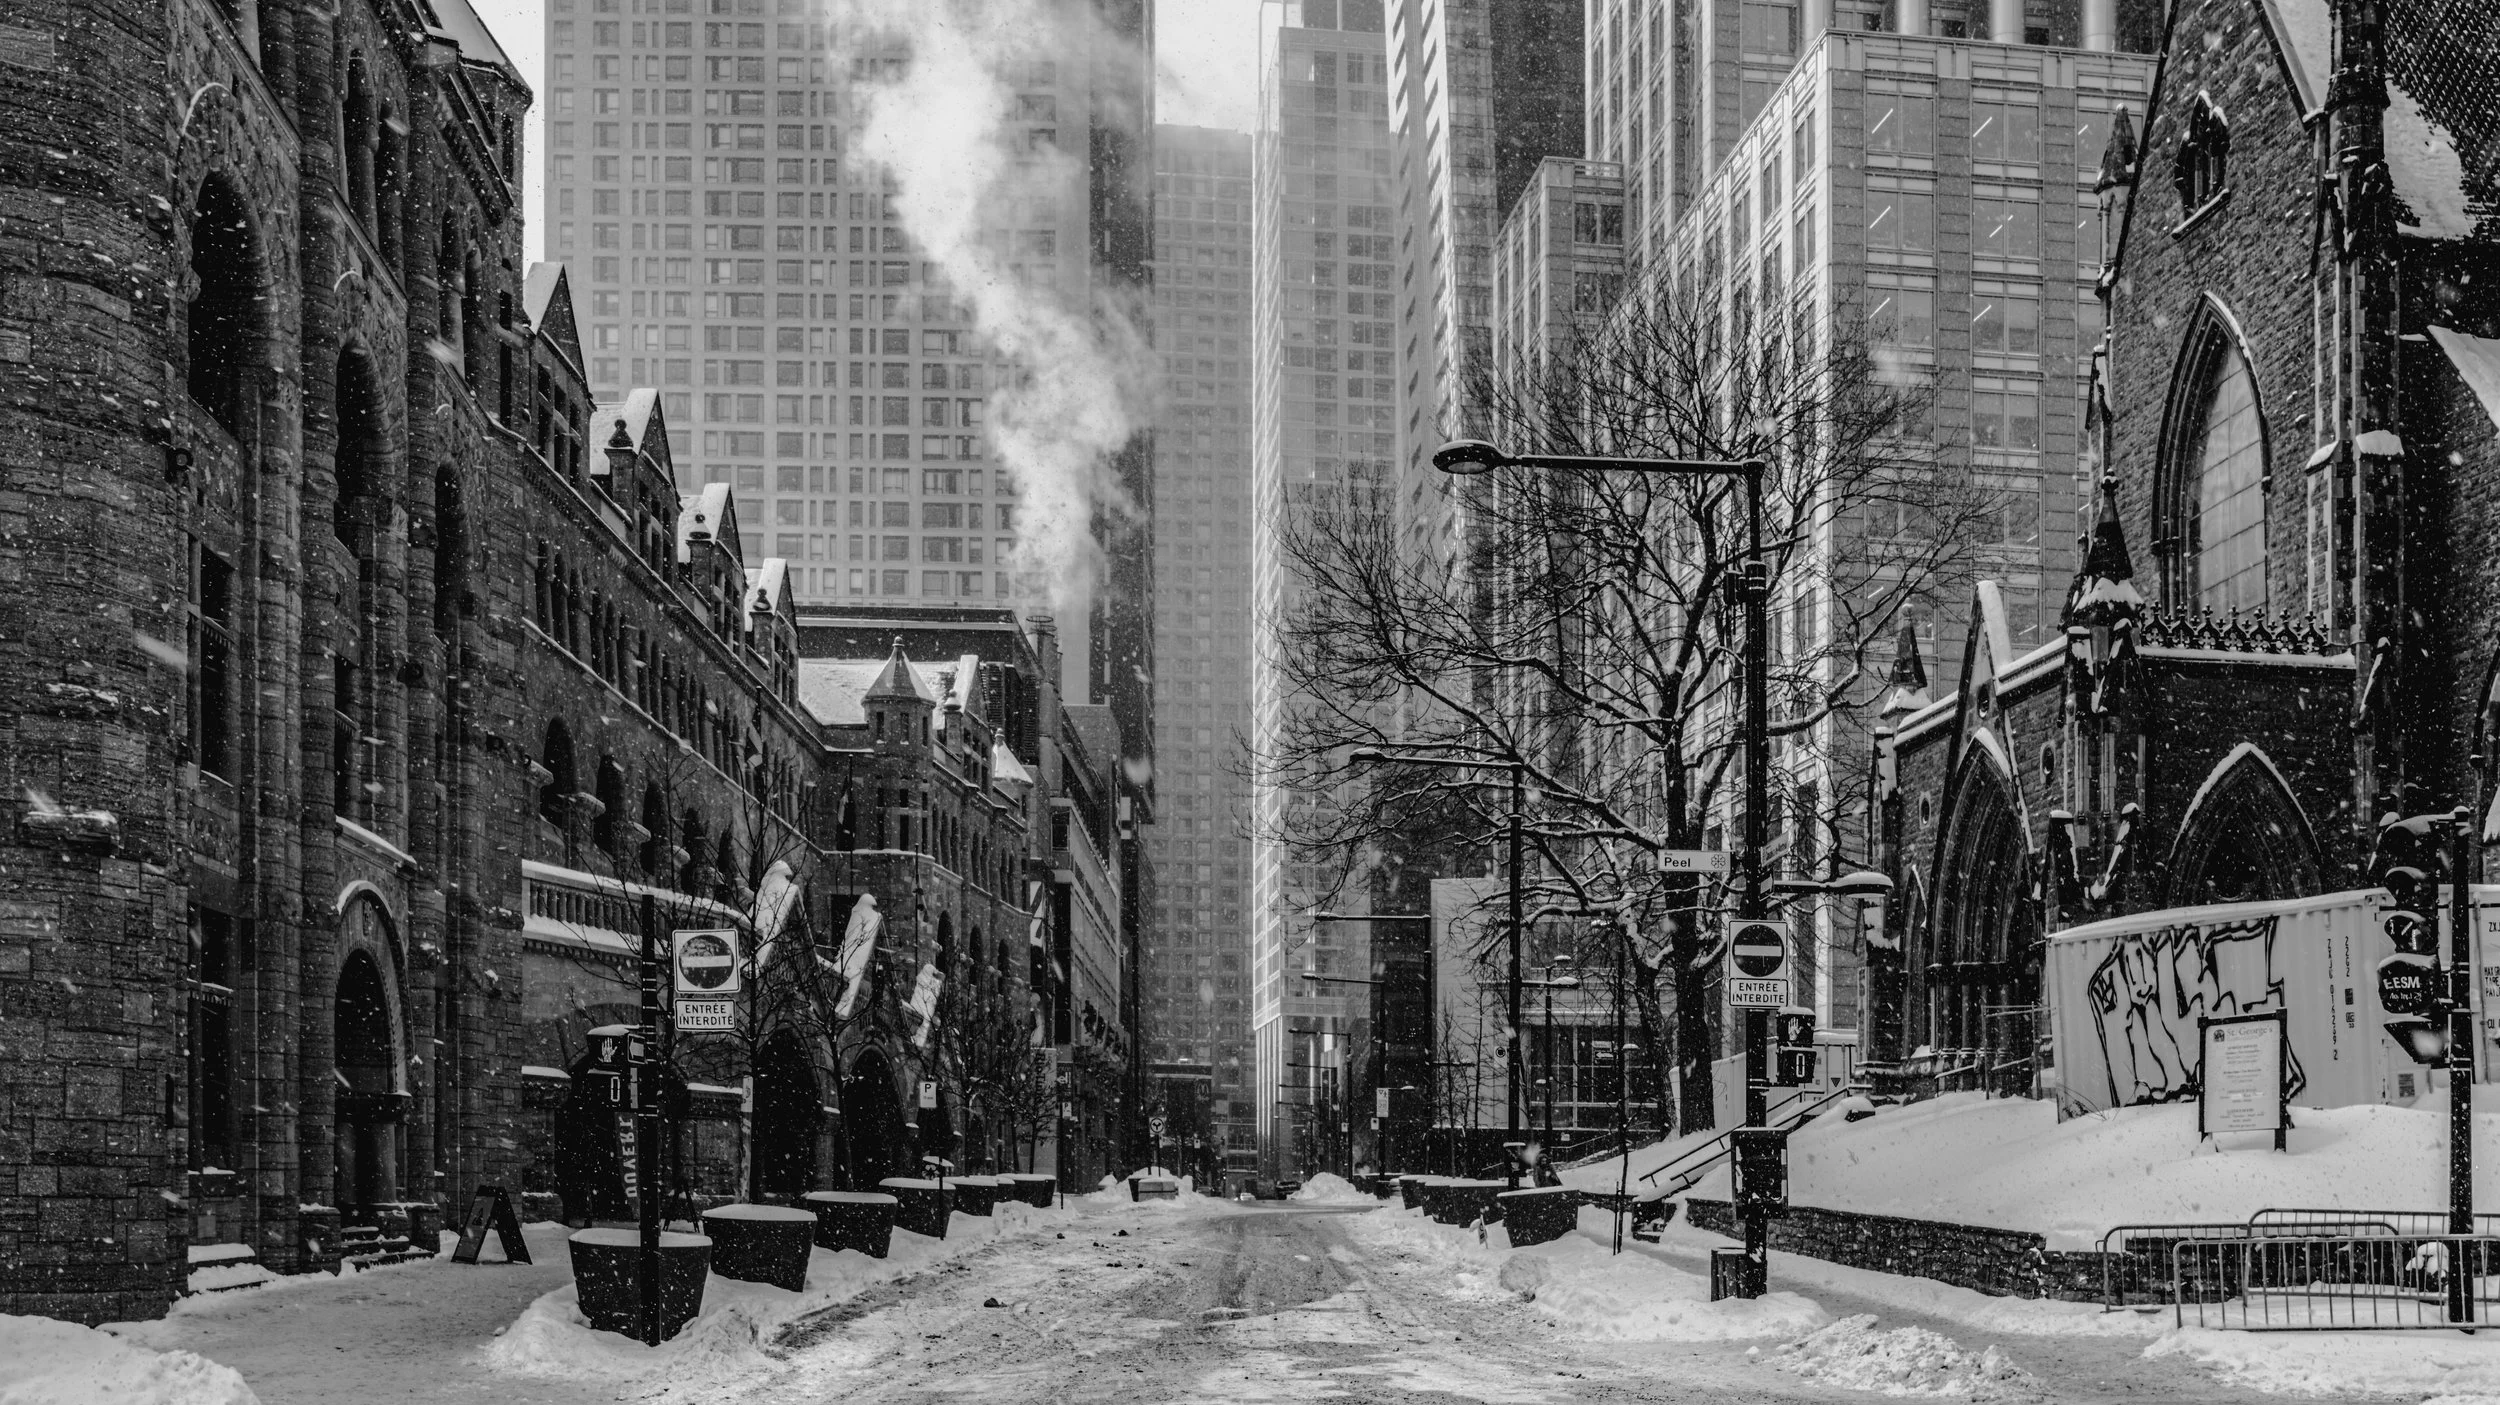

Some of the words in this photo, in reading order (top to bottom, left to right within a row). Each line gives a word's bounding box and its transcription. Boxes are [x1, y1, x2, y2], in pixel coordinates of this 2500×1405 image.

[1664, 857, 1691, 867] Peel
[1739, 981, 1778, 992] ENTRÉE
[2383, 976, 2420, 990] EESM
[1732, 993, 1785, 1003] INTERDITE
[685, 1003, 727, 1014] ENTRÉE
[1796, 1053, 1805, 1078] 0
[610, 1076, 620, 1102] 0
[924, 1083, 931, 1093] P
